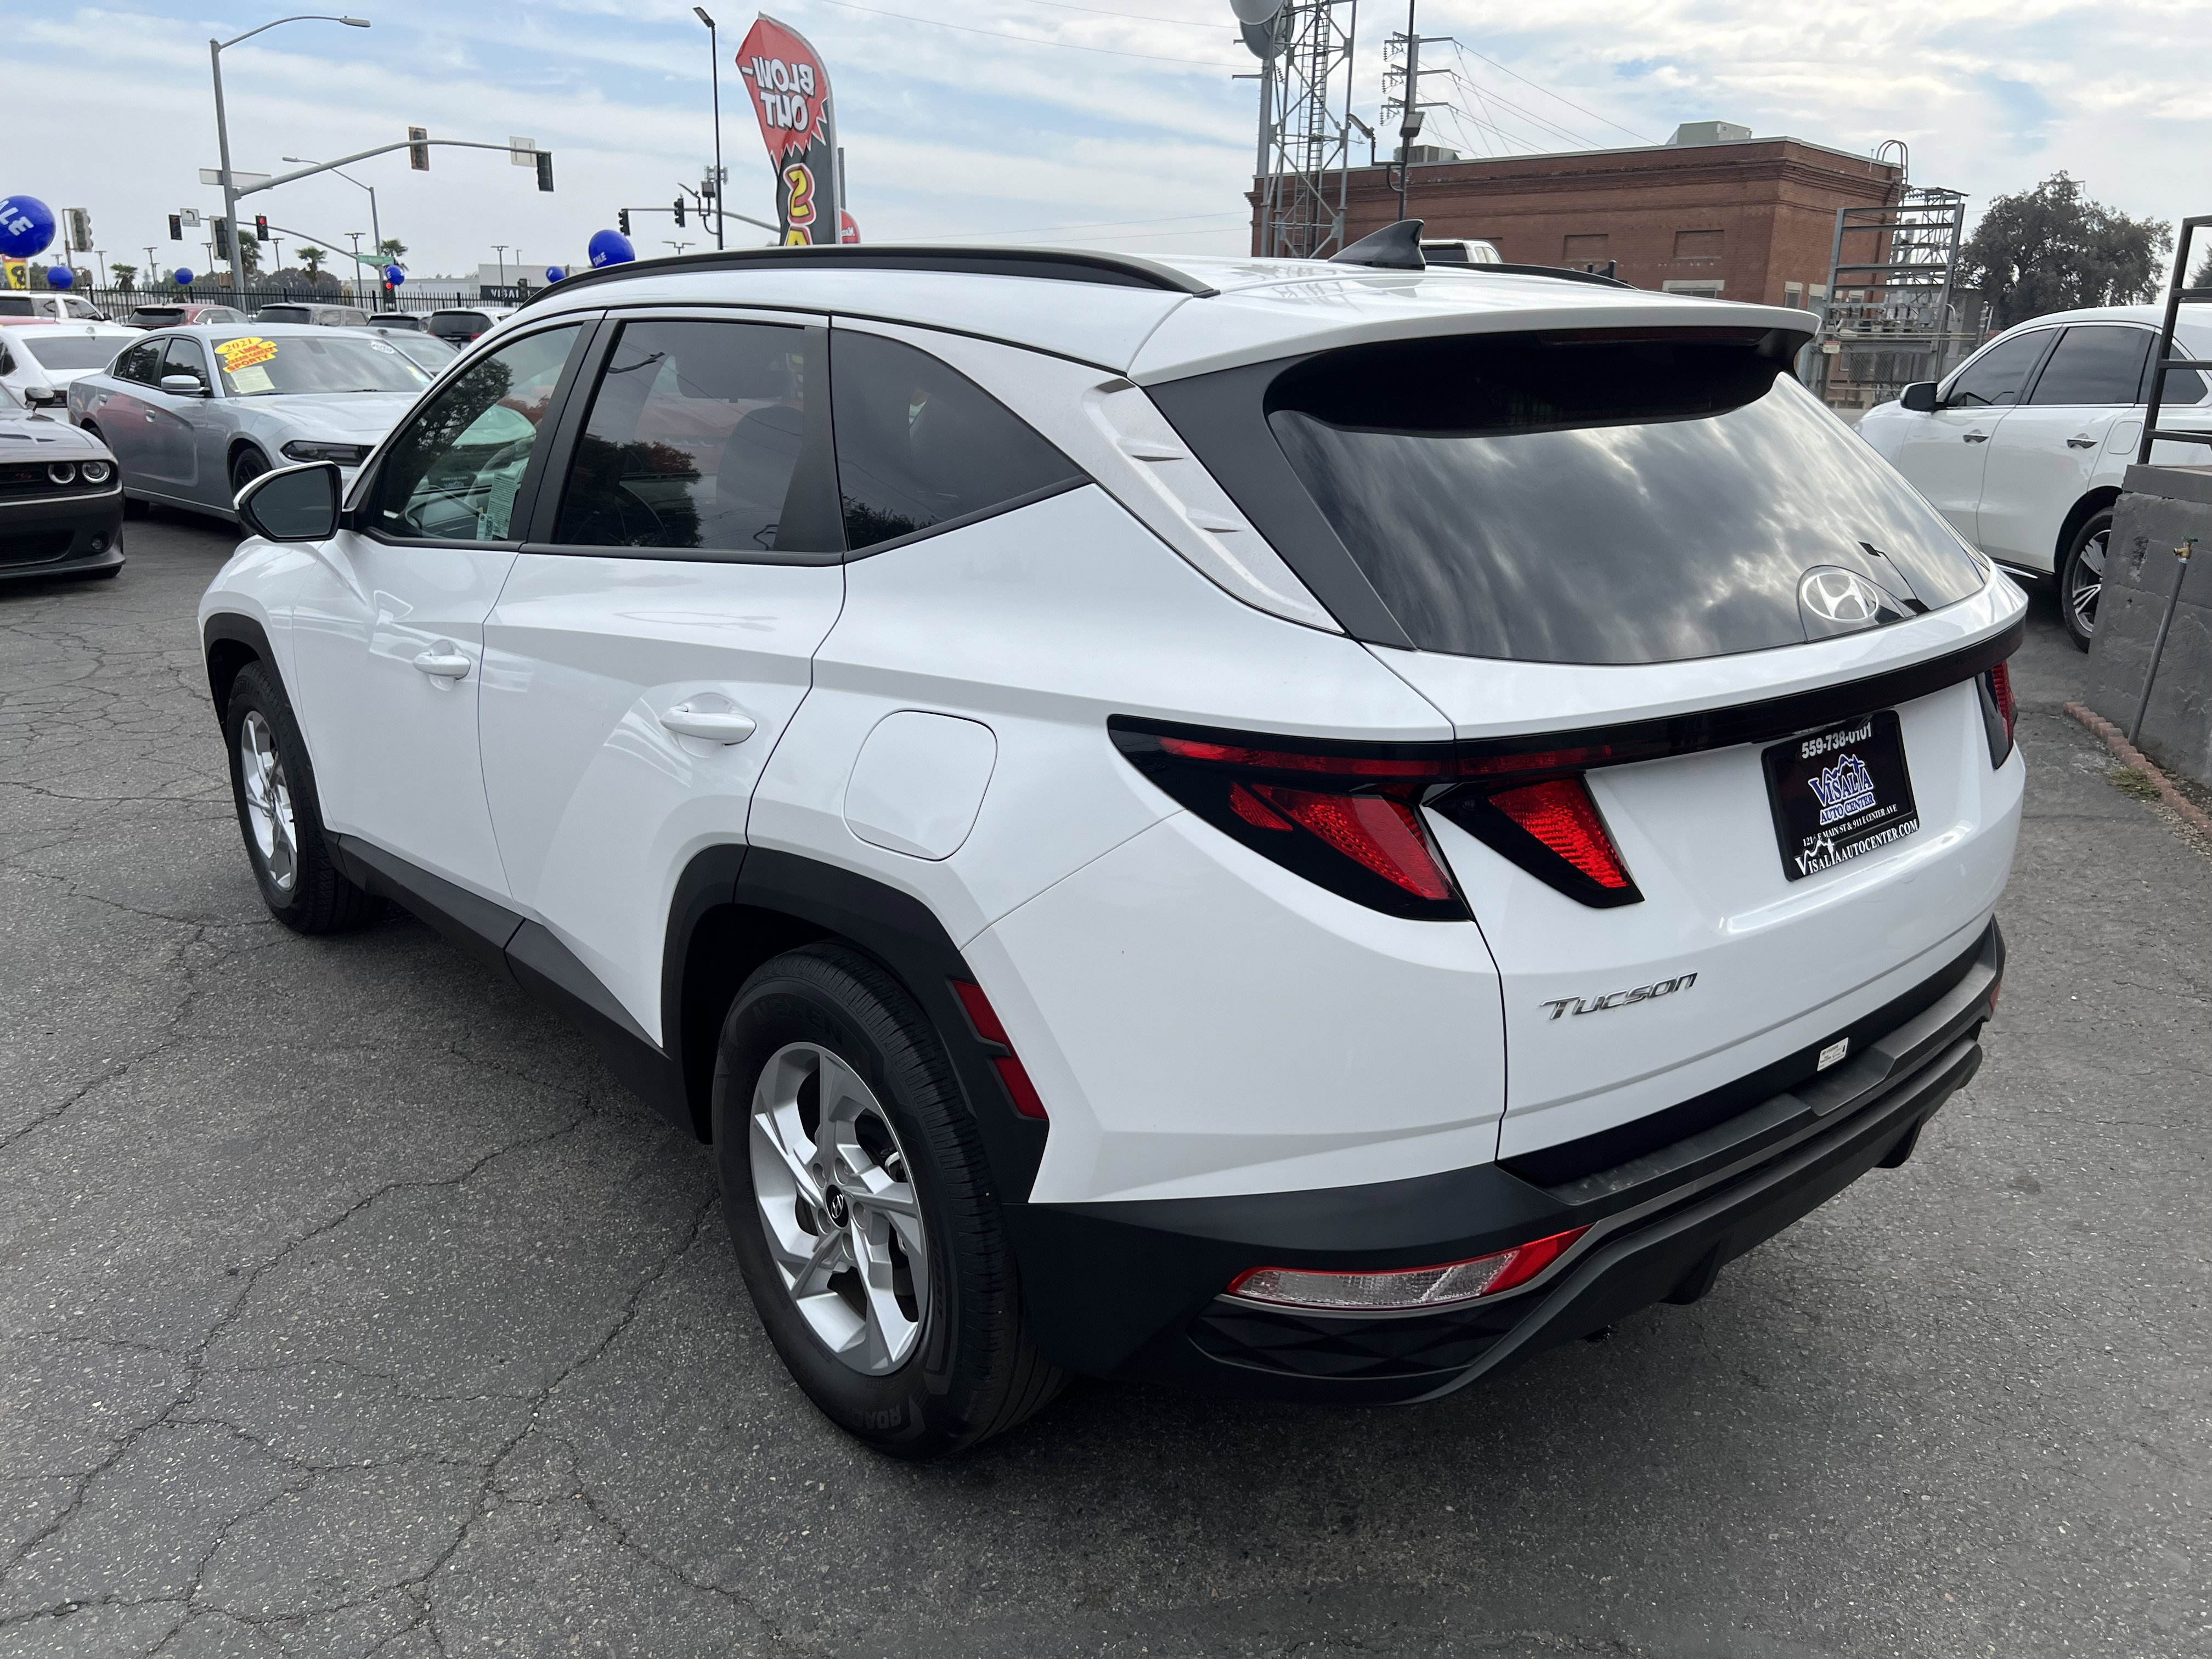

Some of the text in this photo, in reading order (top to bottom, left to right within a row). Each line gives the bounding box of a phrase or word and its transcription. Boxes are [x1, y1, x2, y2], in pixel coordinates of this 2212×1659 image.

[225, 338, 252, 352] 2021
[1802, 721, 1872, 759] 559-738-0101
[1808, 767, 1874, 808] VISALIA
[1803, 835, 1816, 847] 121
[1822, 826, 1839, 838] MAIN
[1839, 823, 1847, 833] ST
[1847, 822, 1853, 831] &
[1853, 817, 1862, 830] 911
[1865, 807, 1886, 822] CENTER
[1886, 803, 1898, 814] AVE
[1820, 792, 1876, 826] AUTO CENTER
[1795, 819, 1919, 876] VISALIAAUTOCENTER.COM
[1539, 972, 1698, 1020] TUCSON
